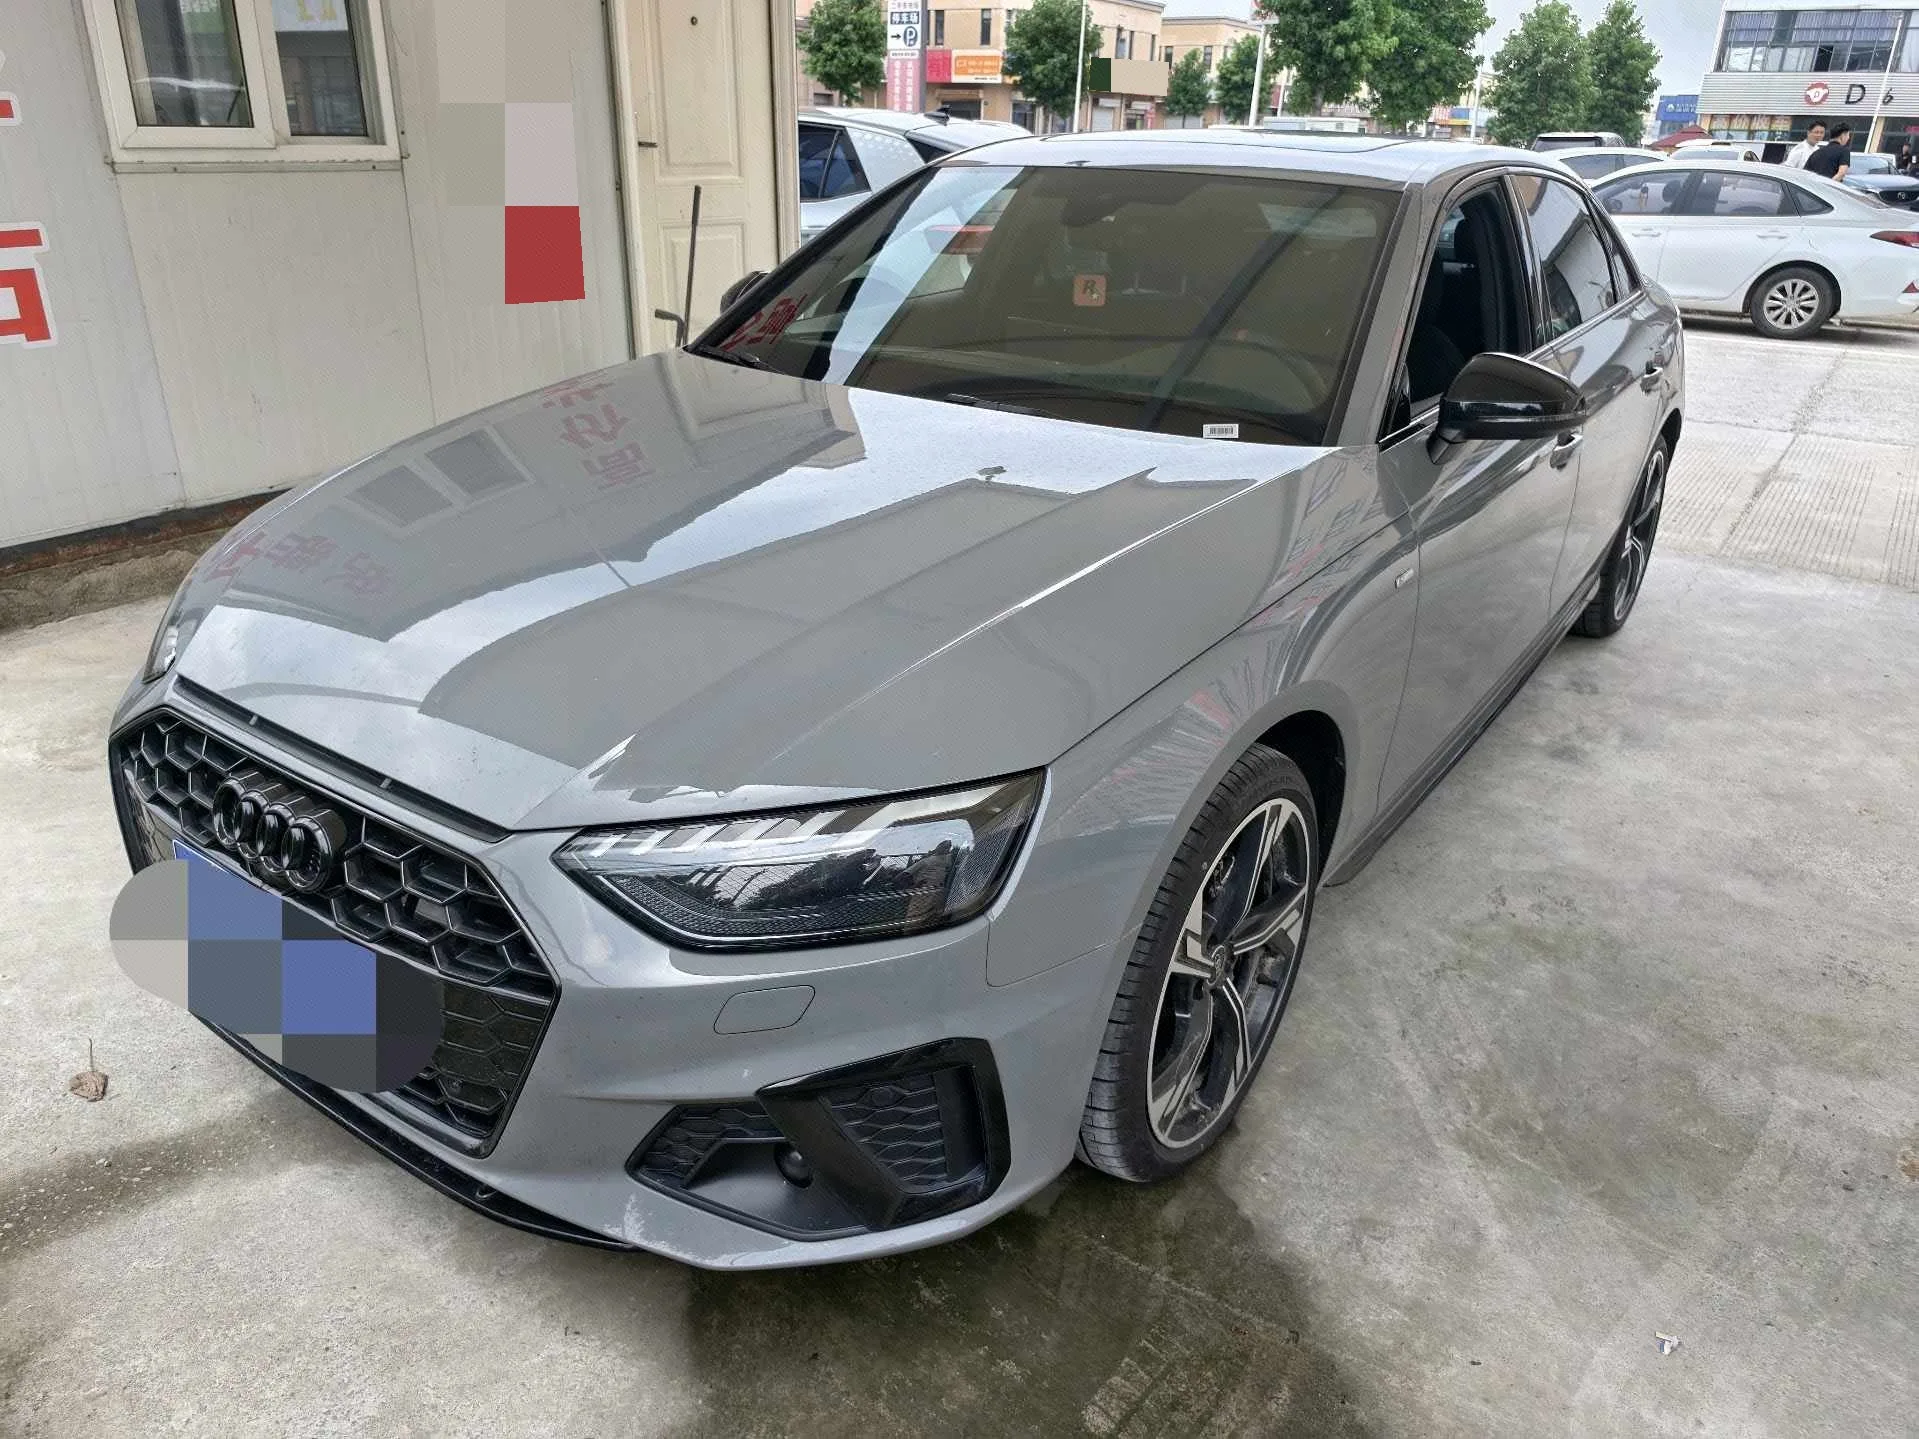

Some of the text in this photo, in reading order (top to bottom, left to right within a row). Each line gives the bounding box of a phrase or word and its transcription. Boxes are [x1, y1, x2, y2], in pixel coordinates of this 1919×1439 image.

[892, 12, 918, 24] 停车场
[1845, 83, 1866, 105] D
